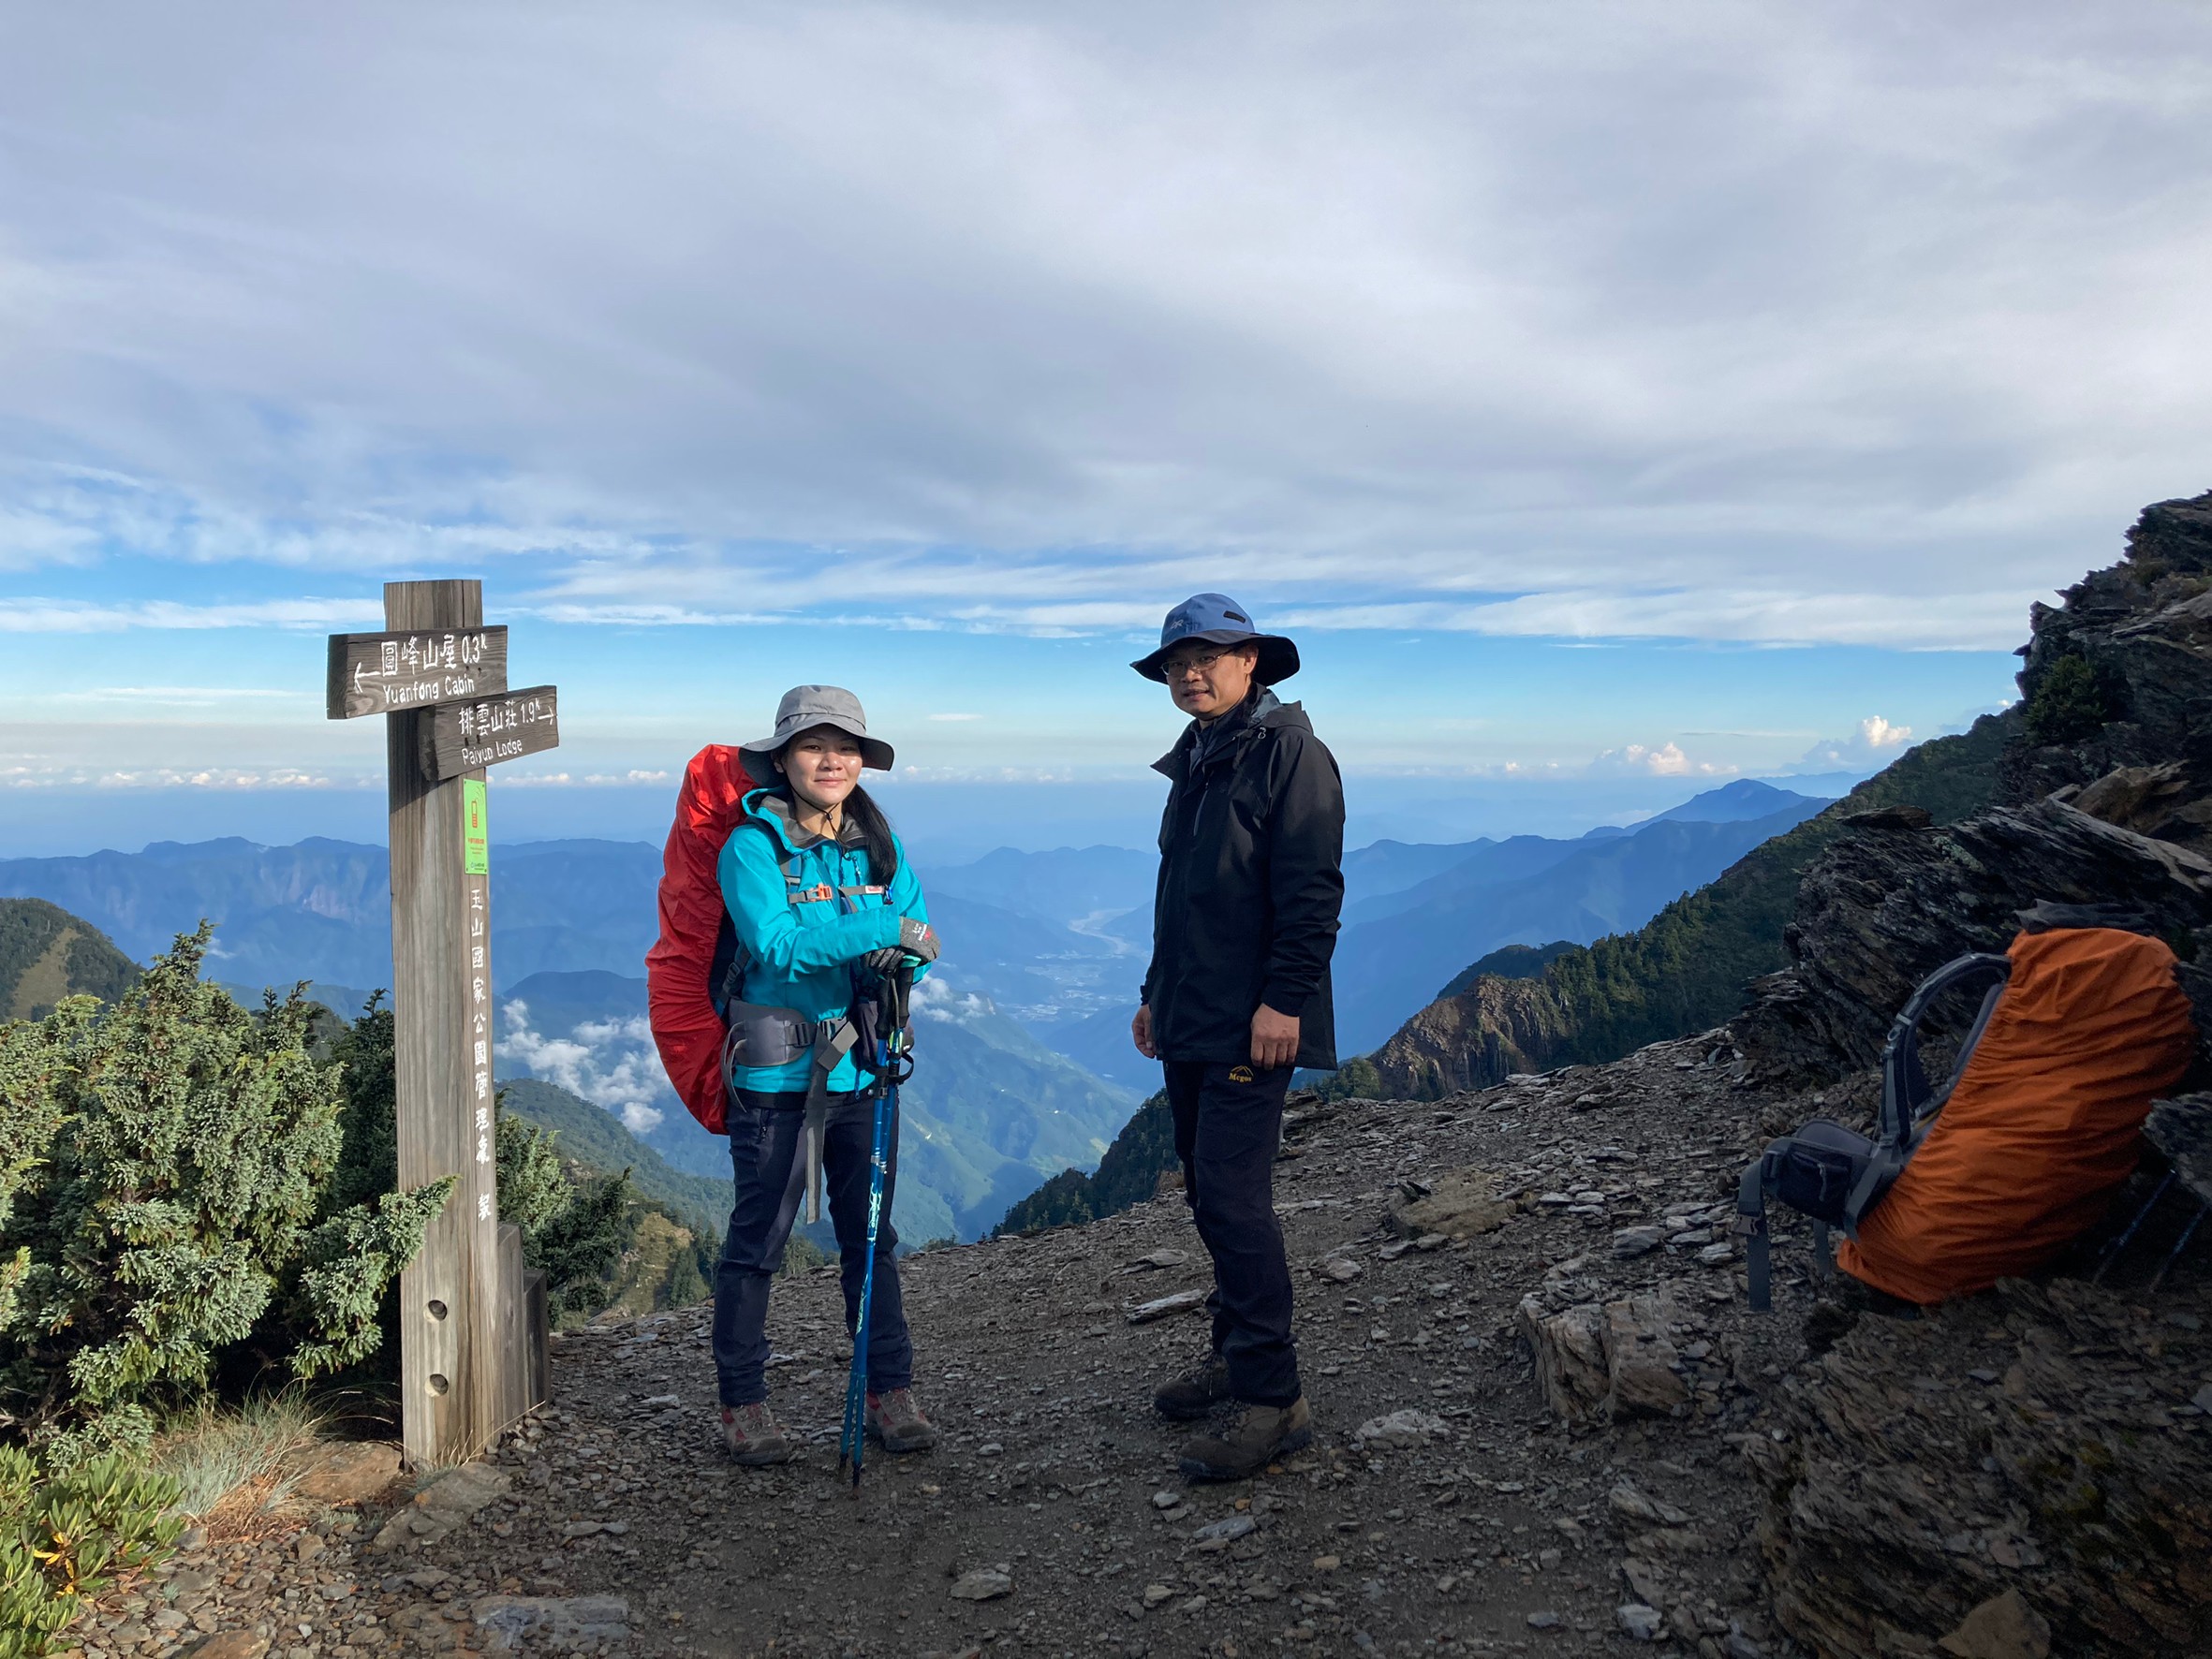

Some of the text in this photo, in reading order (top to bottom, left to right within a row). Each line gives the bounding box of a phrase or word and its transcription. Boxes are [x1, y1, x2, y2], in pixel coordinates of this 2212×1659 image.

[381, 634, 457, 677] 圓峰山屋
[383, 674, 475, 705] Yuanfong Cabin
[459, 700, 517, 736] 排雲山莊
[462, 738, 523, 766] Paiyun Lodge
